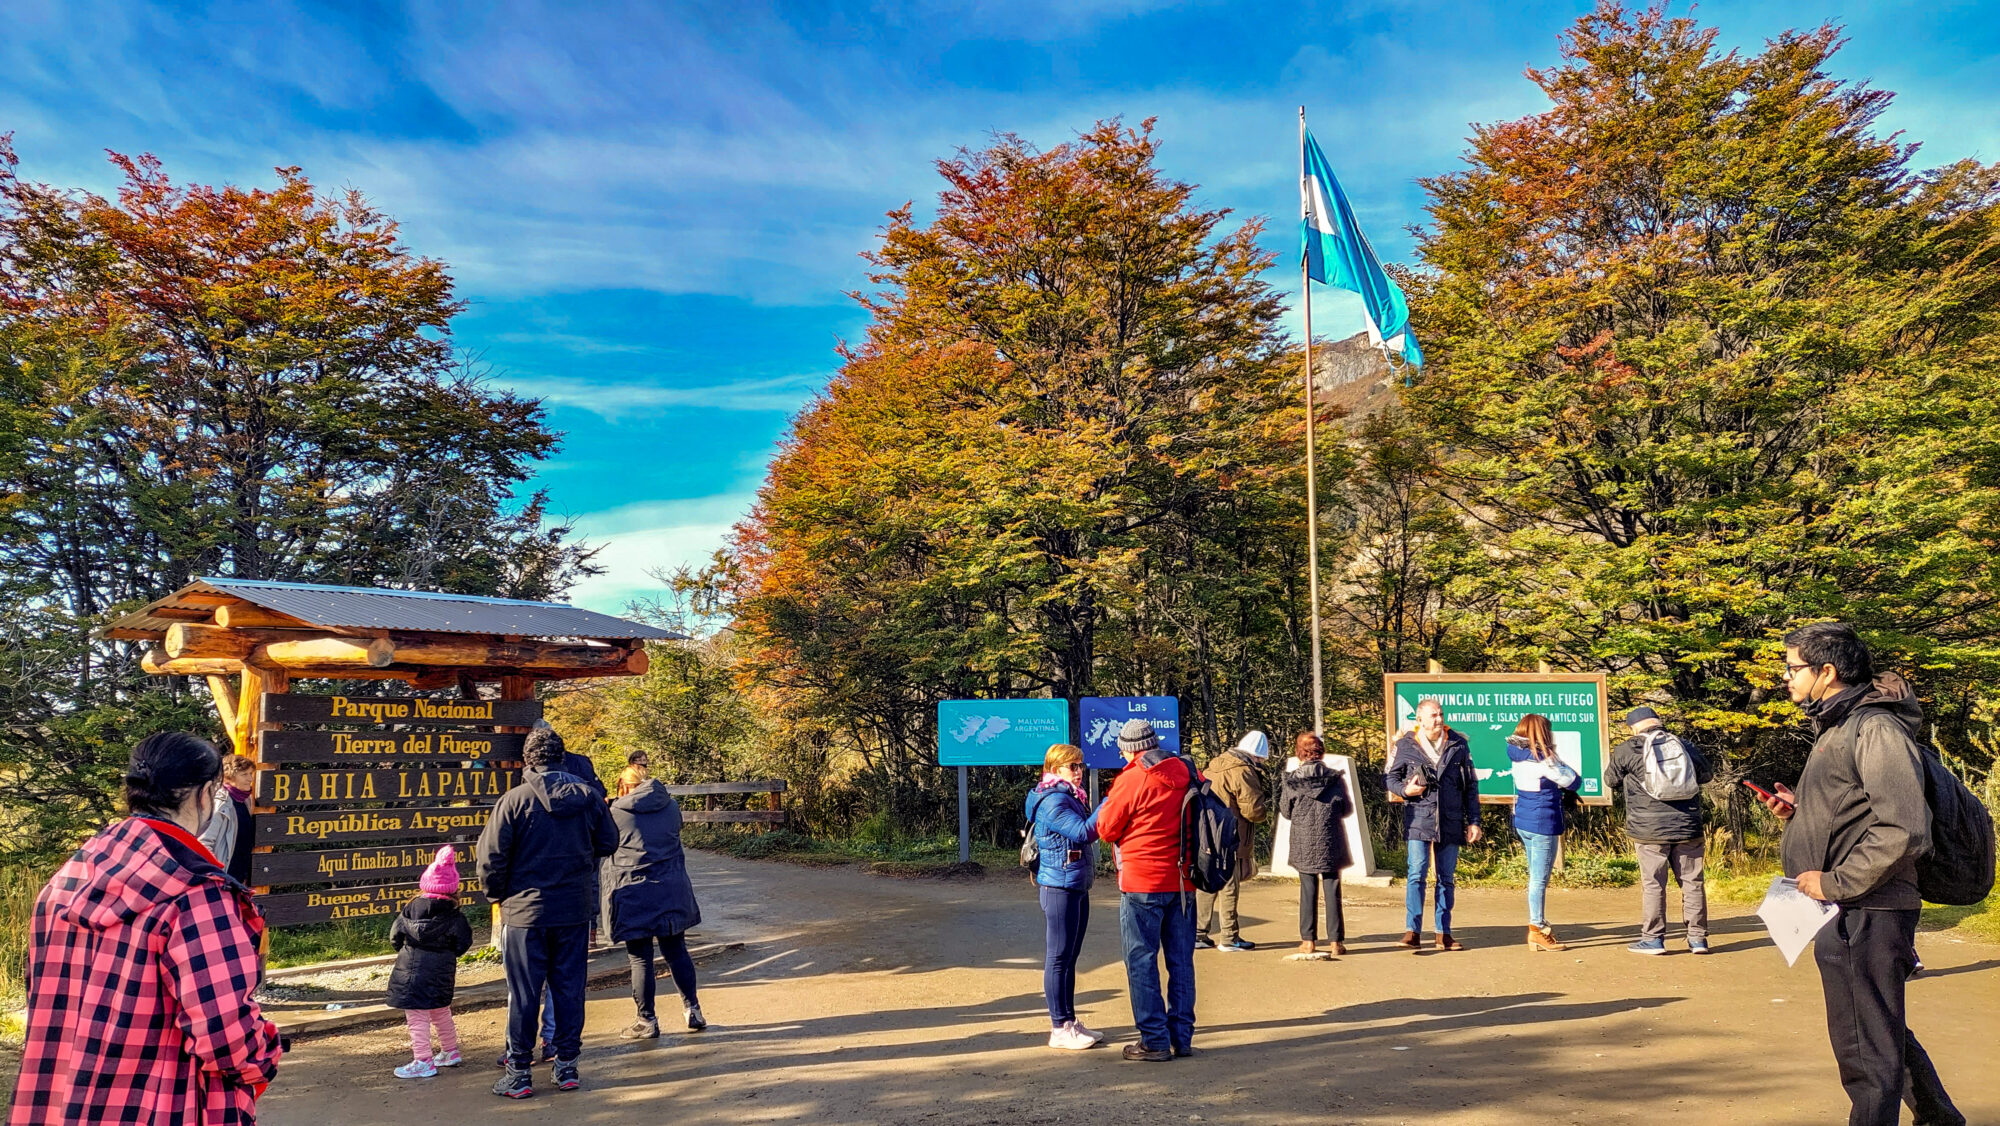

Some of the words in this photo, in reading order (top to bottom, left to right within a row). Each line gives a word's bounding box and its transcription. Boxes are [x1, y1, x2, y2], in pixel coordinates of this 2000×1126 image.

[330, 696, 409, 723] Parque
[413, 698, 494, 720] Nacional
[1128, 701, 1148, 712] Las
[1477, 693, 1491, 706] DE
[1493, 693, 1532, 706] TIERRA
[1534, 693, 1555, 706] DEL
[1558, 693, 1594, 706] FUEGO
[1447, 712, 1488, 722] ANTARTIDA
[1489, 712, 1495, 722] E
[1497, 712, 1519, 722] ISLAS
[1579, 712, 1595, 723] SUR
[331, 734, 397, 754] Tierra
[402, 735, 432, 754] del
[438, 735, 492, 760] Fuego
[272, 772, 377, 801] BAHIA
[398, 771, 514, 797] LAPATAI
[285, 813, 403, 839] República
[408, 809, 489, 833] Argenti
[317, 853, 348, 878] Aqui
[351, 850, 399, 871] finaliza
[401, 849, 413, 867] la
[415, 848, 436, 866] Rut
[307, 893, 371, 907] Buenos
[330, 902, 391, 919] Alaska
